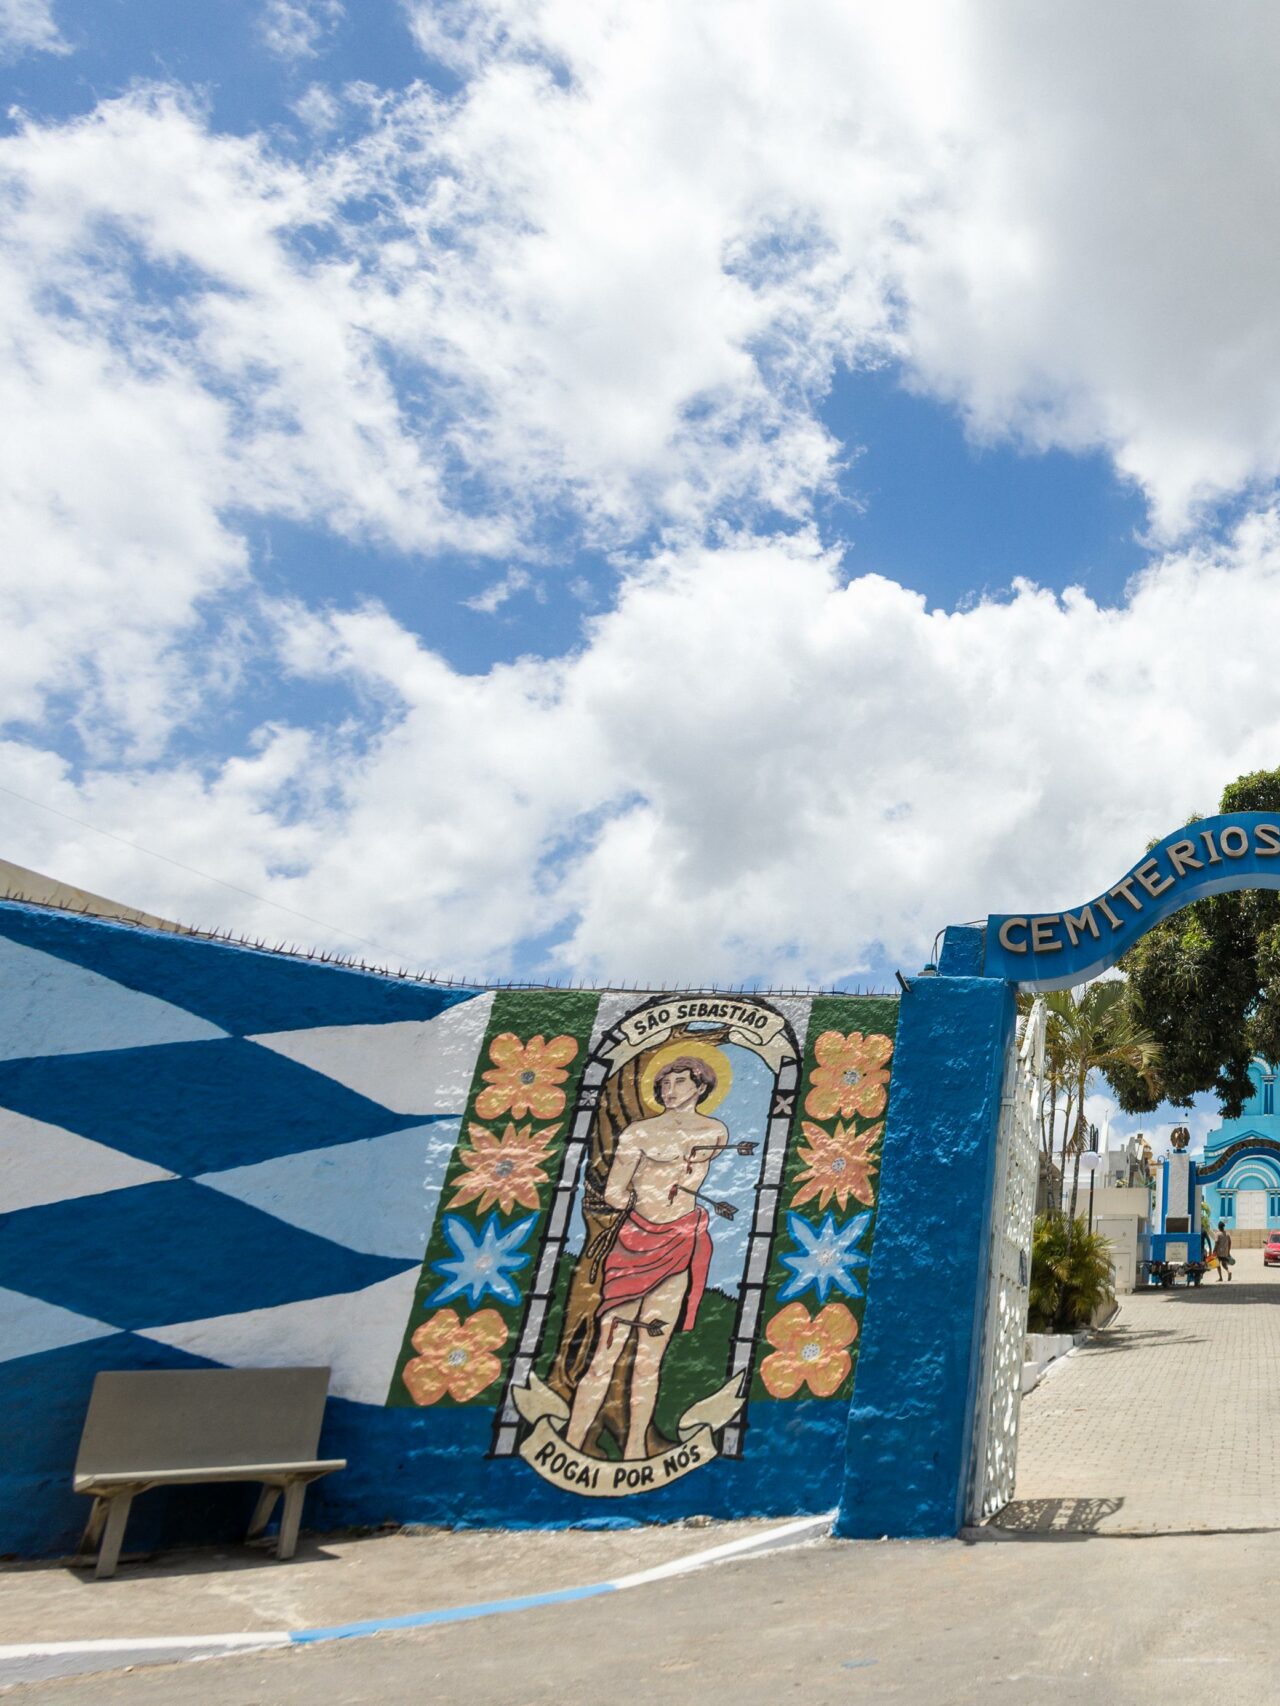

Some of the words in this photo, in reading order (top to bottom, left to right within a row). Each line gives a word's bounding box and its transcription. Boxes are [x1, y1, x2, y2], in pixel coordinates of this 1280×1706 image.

[633, 1009, 670, 1035] SÃO
[677, 1003, 768, 1029] SEBASTIÃO
[534, 1441, 599, 1489] ROGAI
[613, 1466, 655, 1489] POR
[662, 1444, 701, 1477] NÓS
